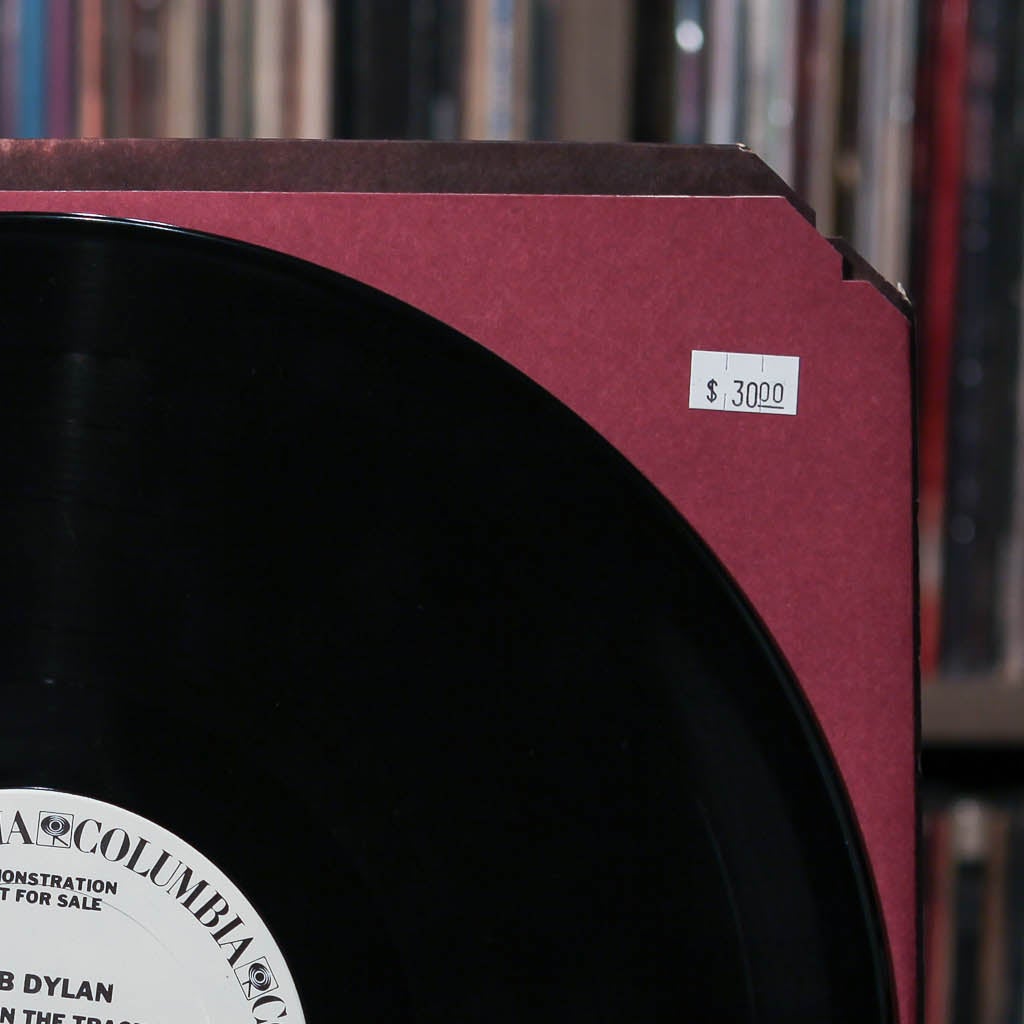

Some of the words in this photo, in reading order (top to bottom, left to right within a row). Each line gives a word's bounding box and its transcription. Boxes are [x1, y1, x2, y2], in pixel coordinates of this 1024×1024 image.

[16, 889, 52, 906] FOR
[57, 894, 102, 911] SALE
[73, 818, 254, 968] COLUMBIA
[23, 973, 114, 1003] DYLAN
